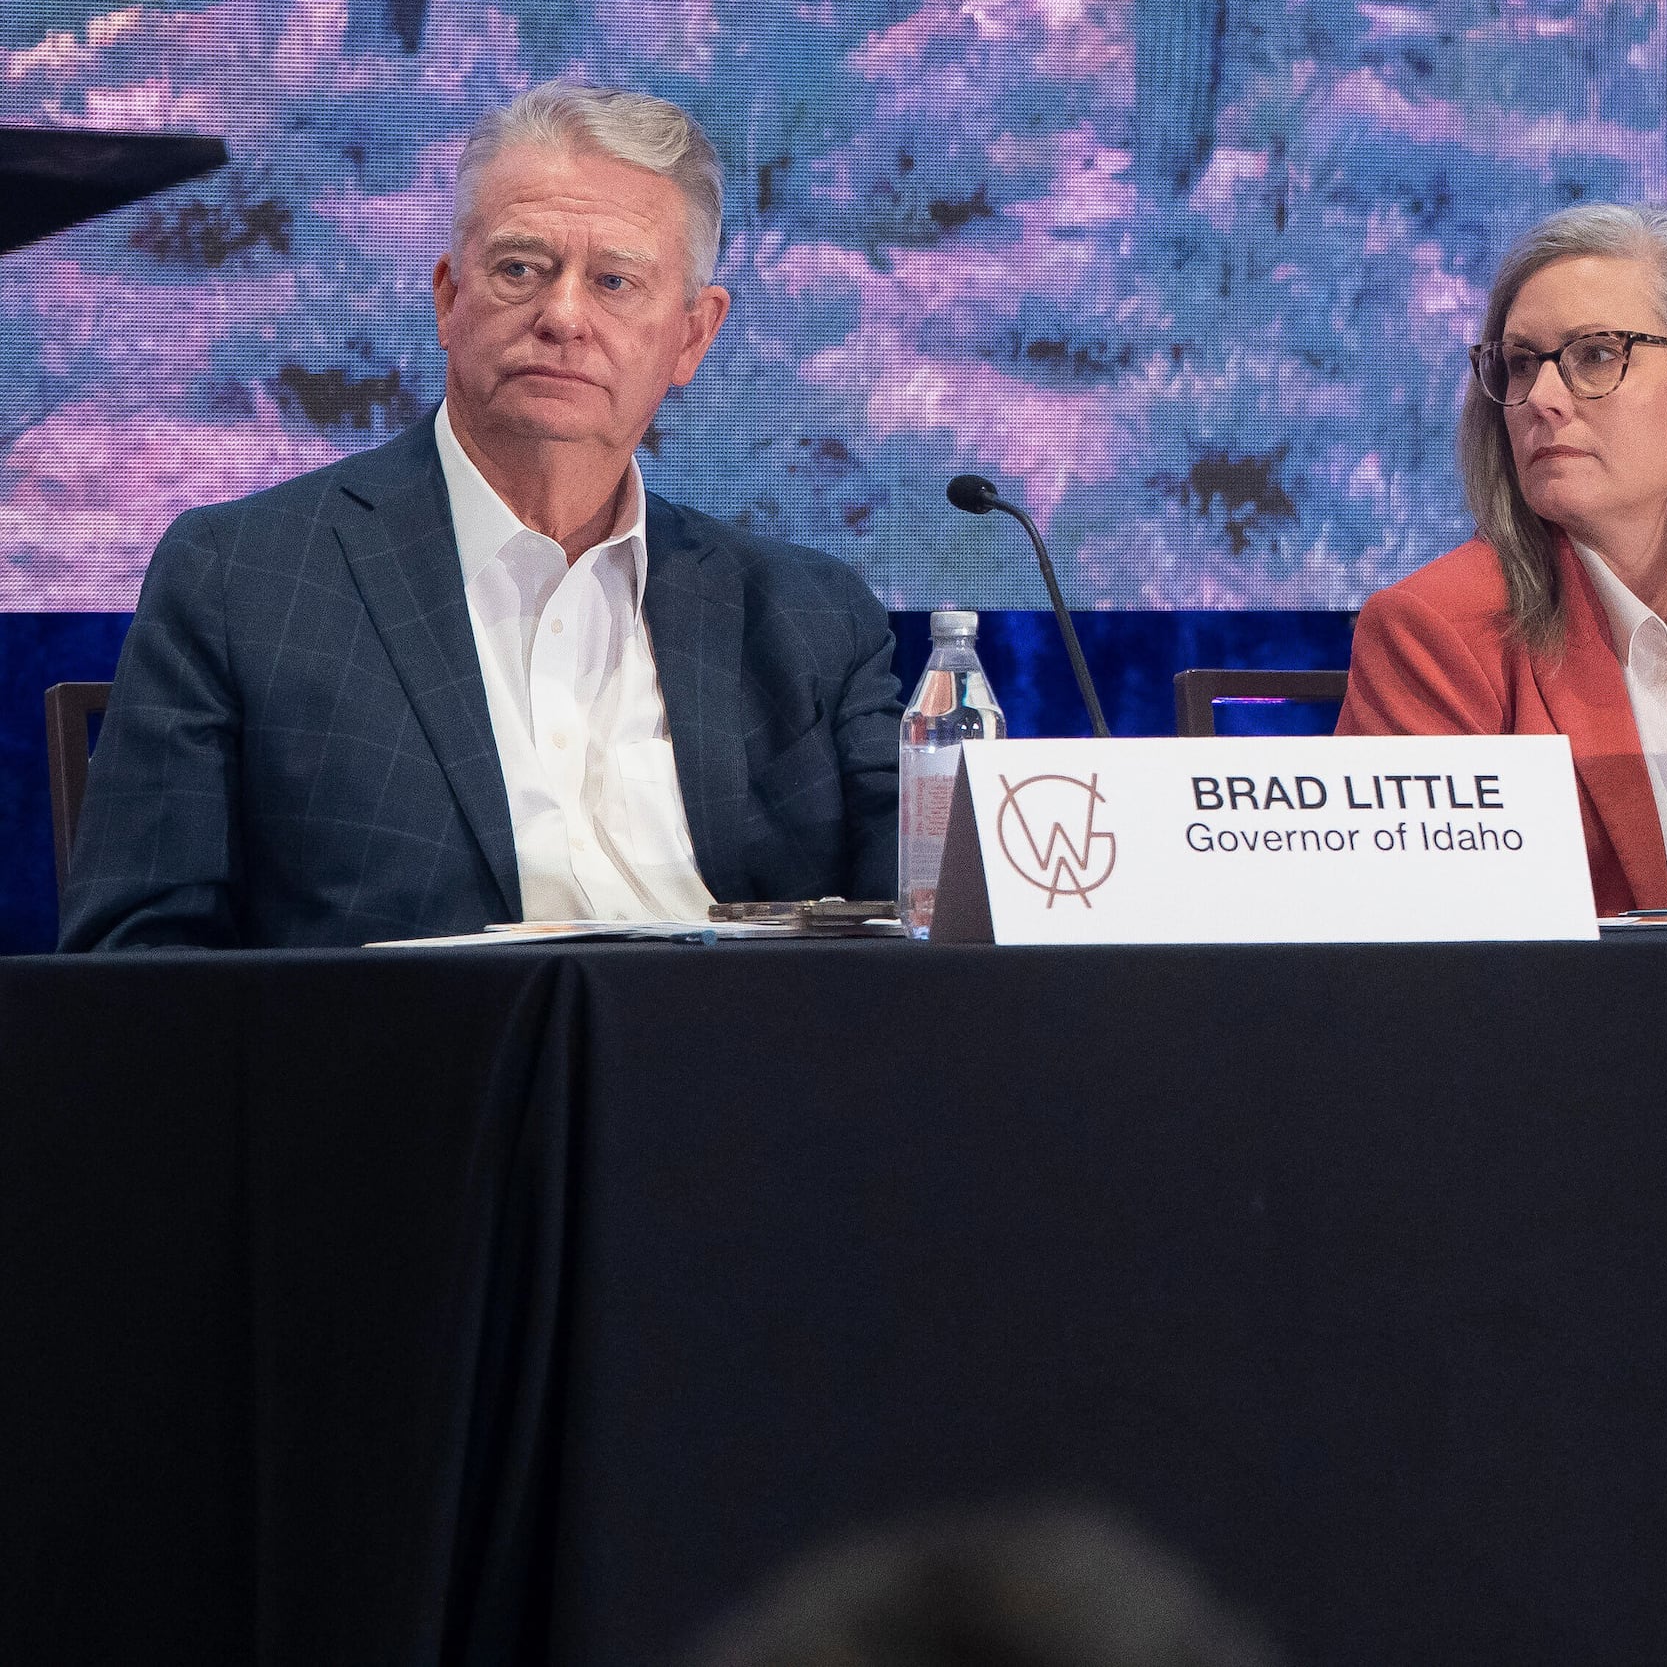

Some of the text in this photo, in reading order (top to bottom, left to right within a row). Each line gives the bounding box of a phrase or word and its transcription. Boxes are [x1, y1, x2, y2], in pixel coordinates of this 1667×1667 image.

[1190, 774, 1505, 811] BRAD LITTLE
[1185, 821, 1523, 853] Governor of Idaho
